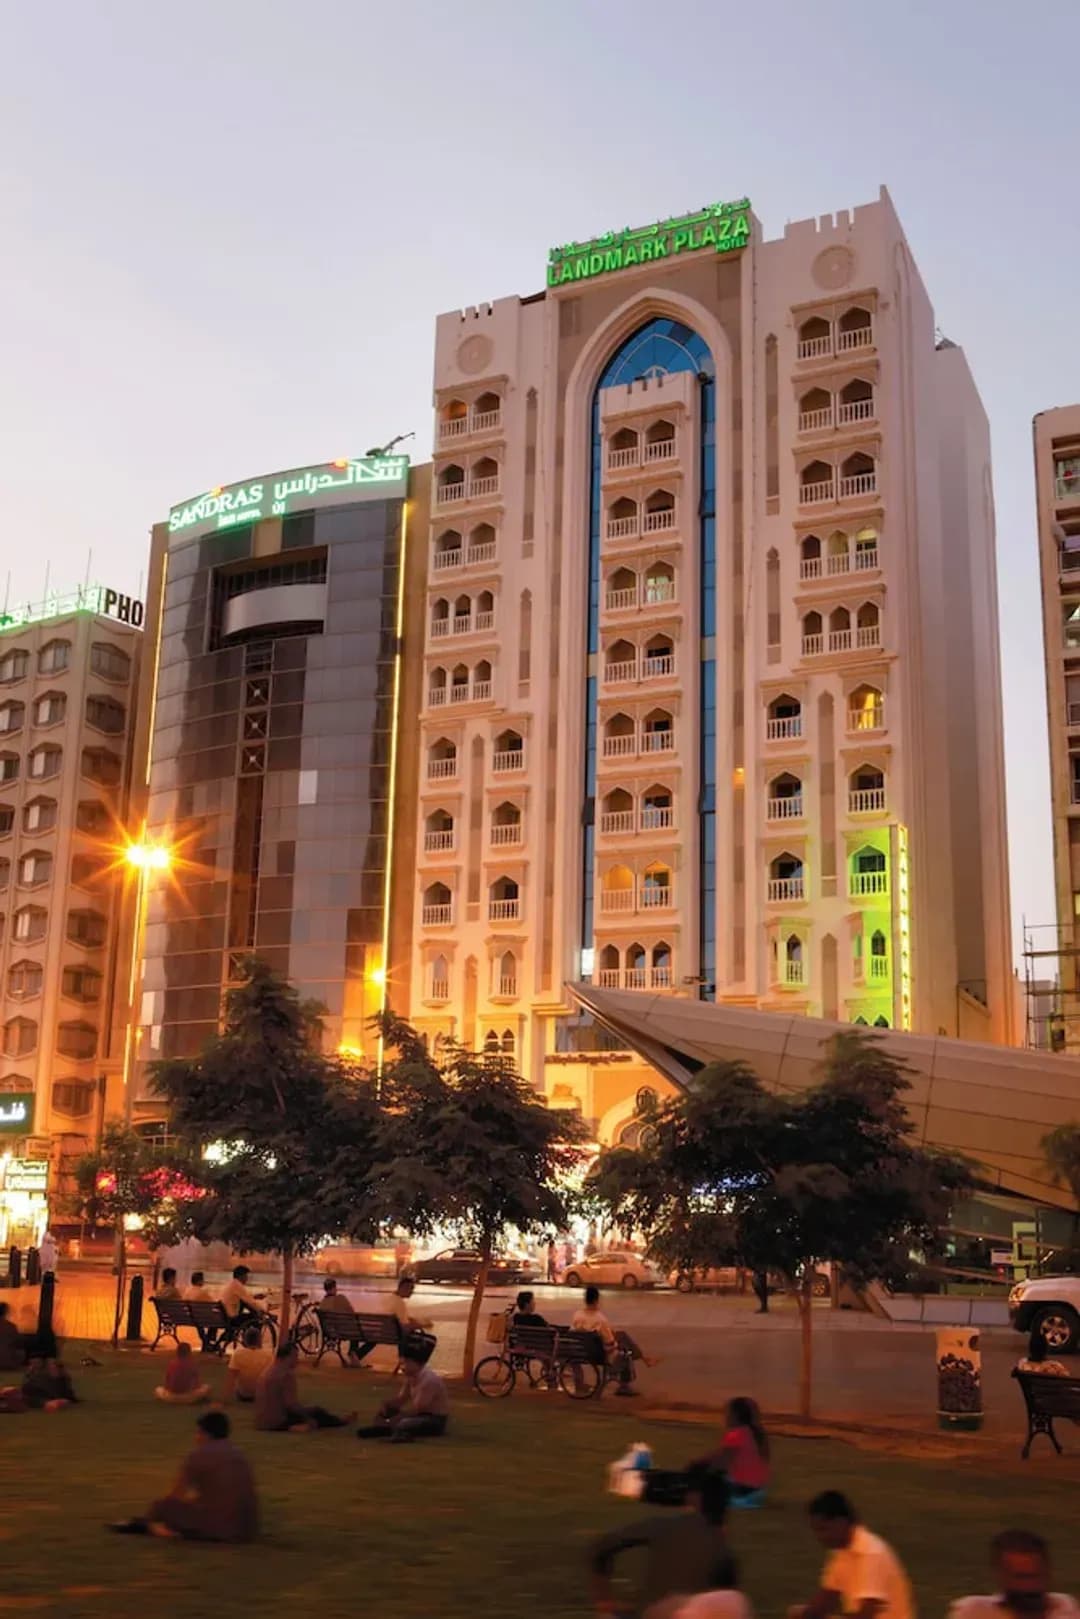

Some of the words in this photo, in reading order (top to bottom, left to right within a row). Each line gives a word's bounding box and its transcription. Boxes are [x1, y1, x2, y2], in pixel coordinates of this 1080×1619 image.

[547, 234, 668, 287] LANDMARK
[673, 214, 749, 253] PLAZA
[716, 236, 747, 252] HOTEL
[168, 484, 263, 532] SANDRAS
[104, 588, 144, 626] PHO
